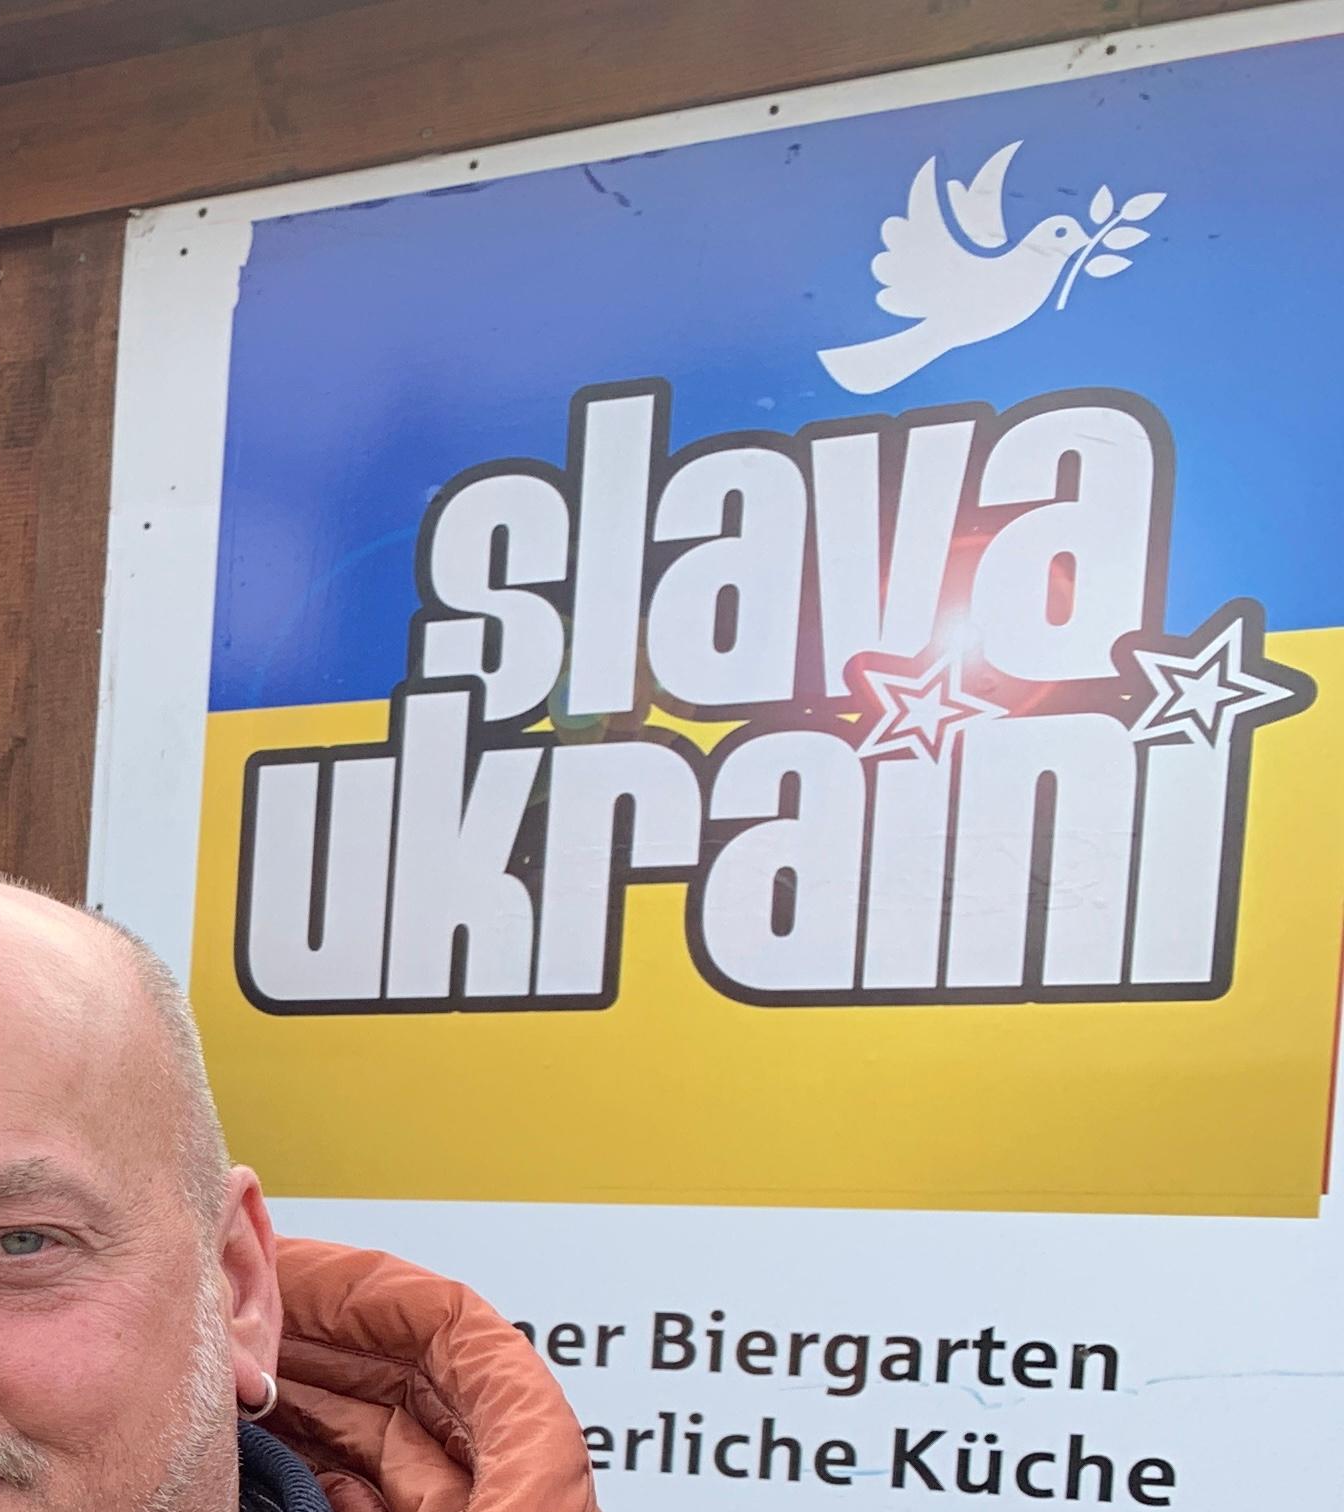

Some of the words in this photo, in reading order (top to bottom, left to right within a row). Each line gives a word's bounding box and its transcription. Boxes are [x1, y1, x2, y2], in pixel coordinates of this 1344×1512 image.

[415, 377, 1174, 724] slava
[234, 608, 1312, 1013] ukraini
[582, 1411, 857, 1486] erliche
[891, 1428, 1177, 1508] Küche
[651, 1310, 1119, 1397] Biergarten
